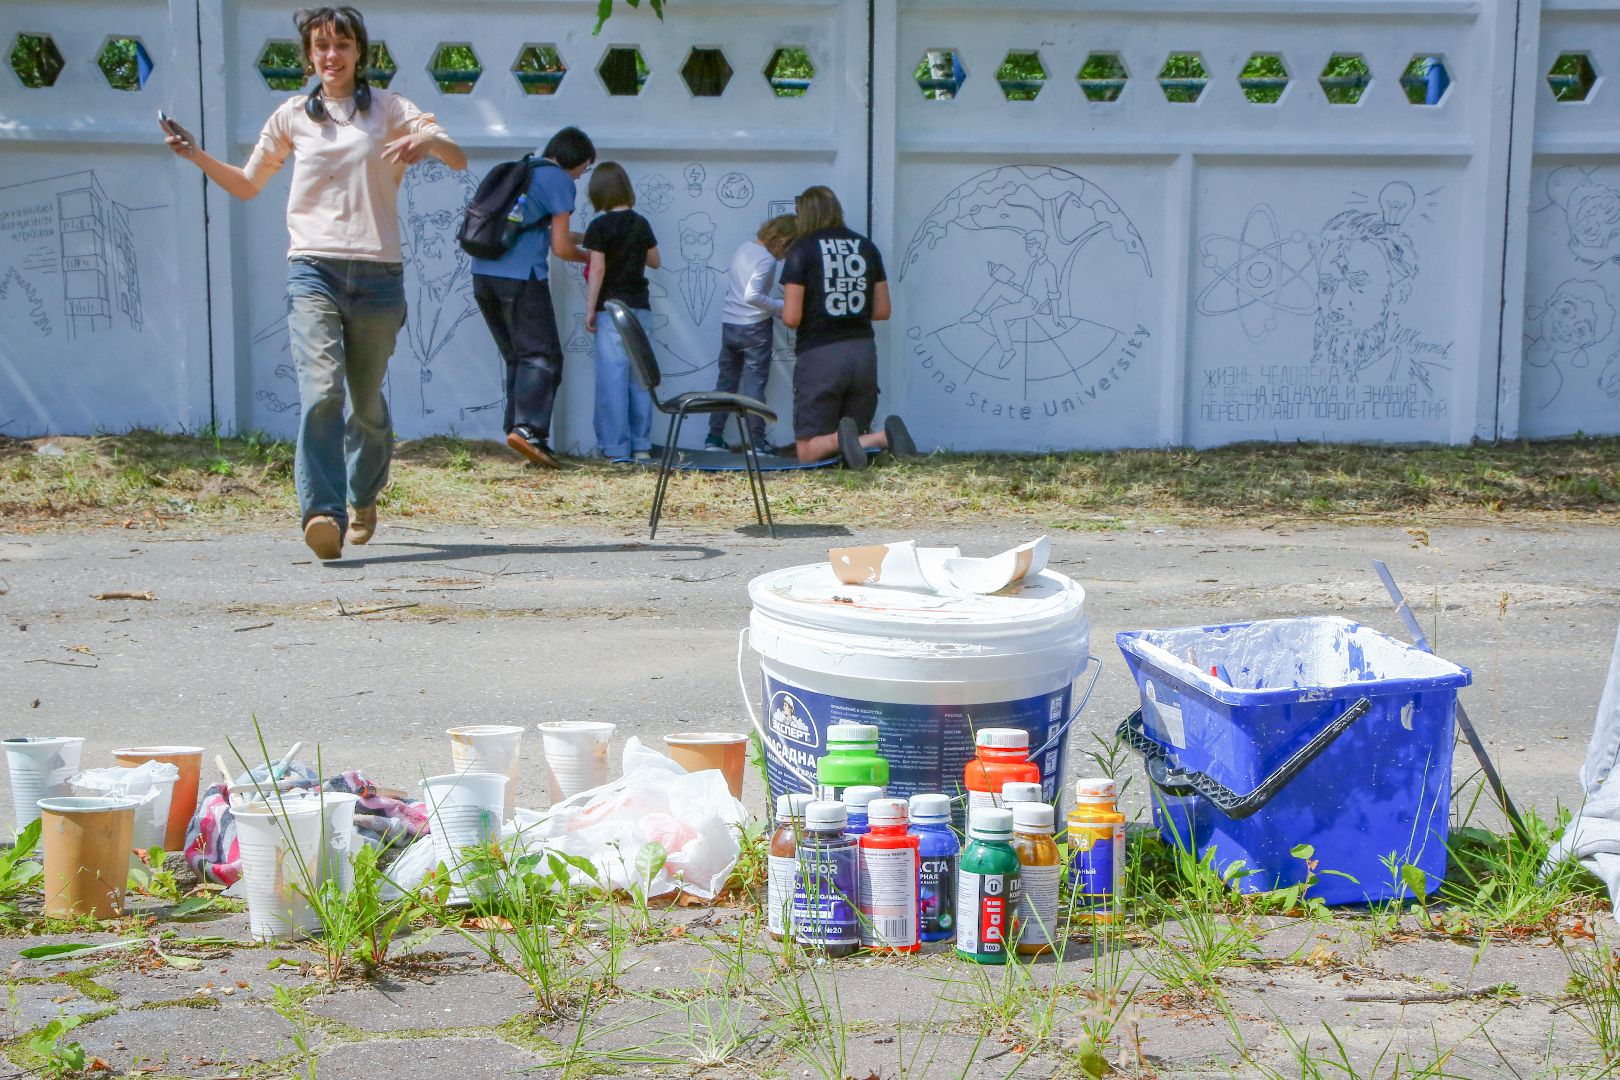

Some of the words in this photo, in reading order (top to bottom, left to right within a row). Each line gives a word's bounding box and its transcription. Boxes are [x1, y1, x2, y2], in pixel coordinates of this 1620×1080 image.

[819, 239, 860, 254] HEY
[823, 254, 866, 278] HO
[824, 277, 867, 292] LETS
[825, 291, 866, 316] GO
[906, 325, 957, 394] Dubna
[966, 392, 1031, 420] State
[1043, 323, 1151, 417] University
[1203, 365, 1252, 388] ЖИЗНЬ
[1261, 365, 1340, 386] ЧЕЛОВЕКА
[1272, 386, 1289, 403] НО
[1294, 385, 1338, 403] НАУКА
[1363, 384, 1416, 403] ЗНАНИЯ
[1201, 402, 1303, 422] ПЕРЕСТУПАЮТ
[1308, 402, 1366, 420] ПОРОГИ
[772, 720, 811, 742] ЭКСПЕРТ
[986, 900, 1001, 940] Dali
